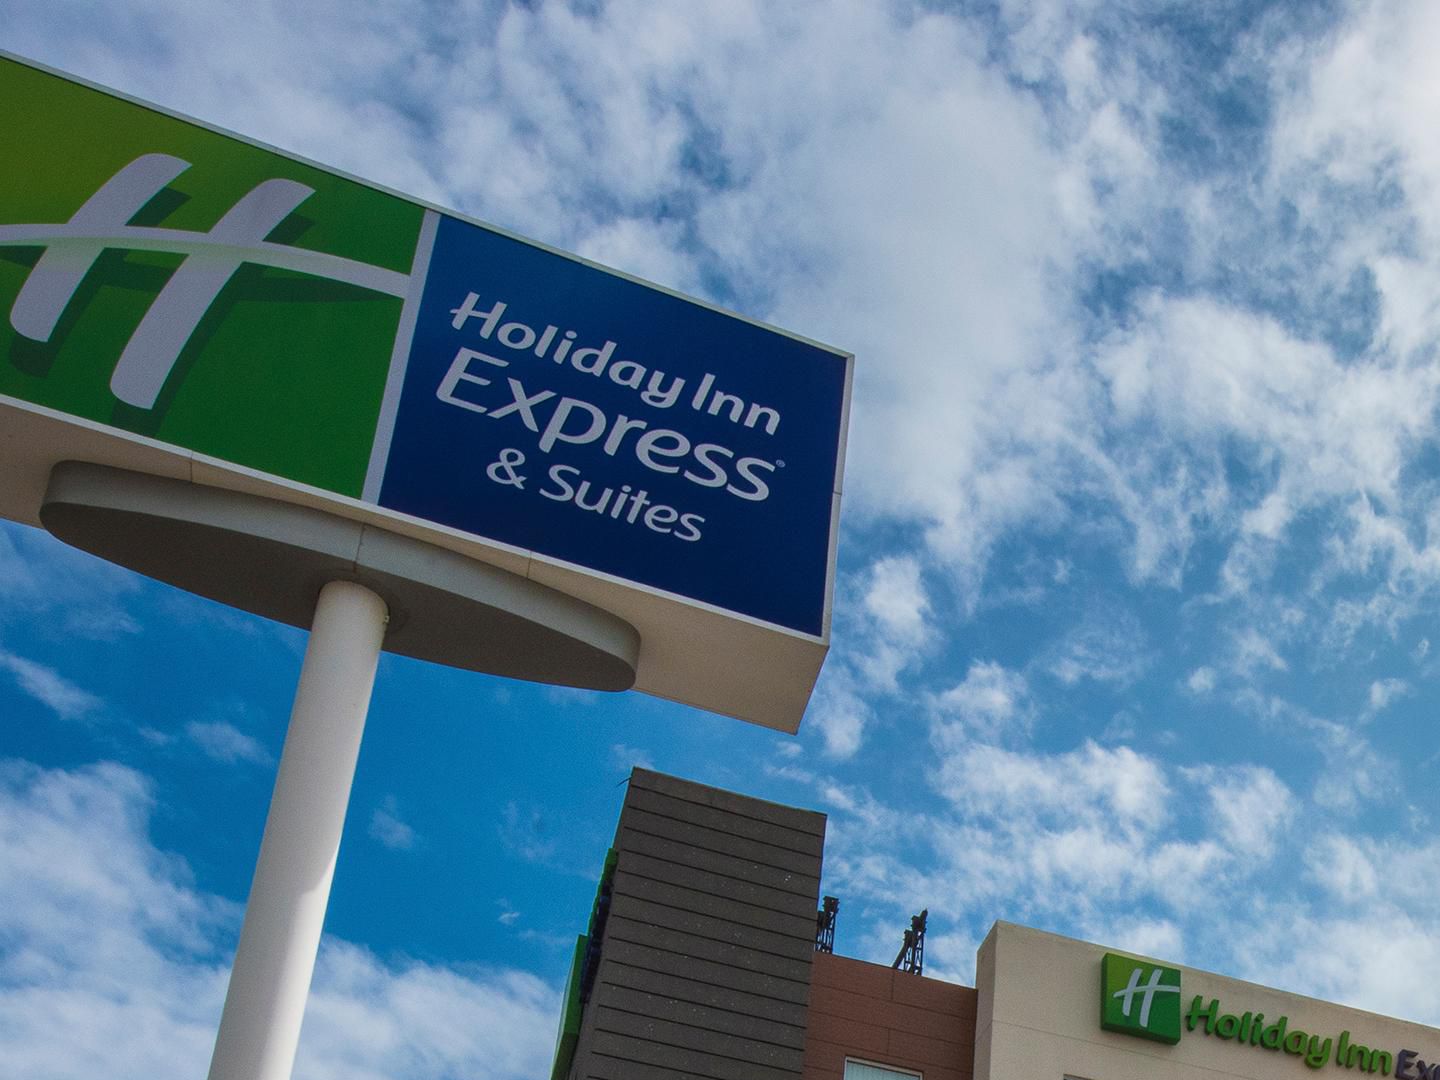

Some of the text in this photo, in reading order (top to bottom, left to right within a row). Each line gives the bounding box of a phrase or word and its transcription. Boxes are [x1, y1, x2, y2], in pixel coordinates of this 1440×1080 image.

[450, 292, 781, 435] Holiday Inn
[436, 347, 776, 501] Express
[486, 448, 705, 542] & Suites
[1185, 995, 1332, 1069] Holiday
[1336, 1030, 1393, 1075] Inn
